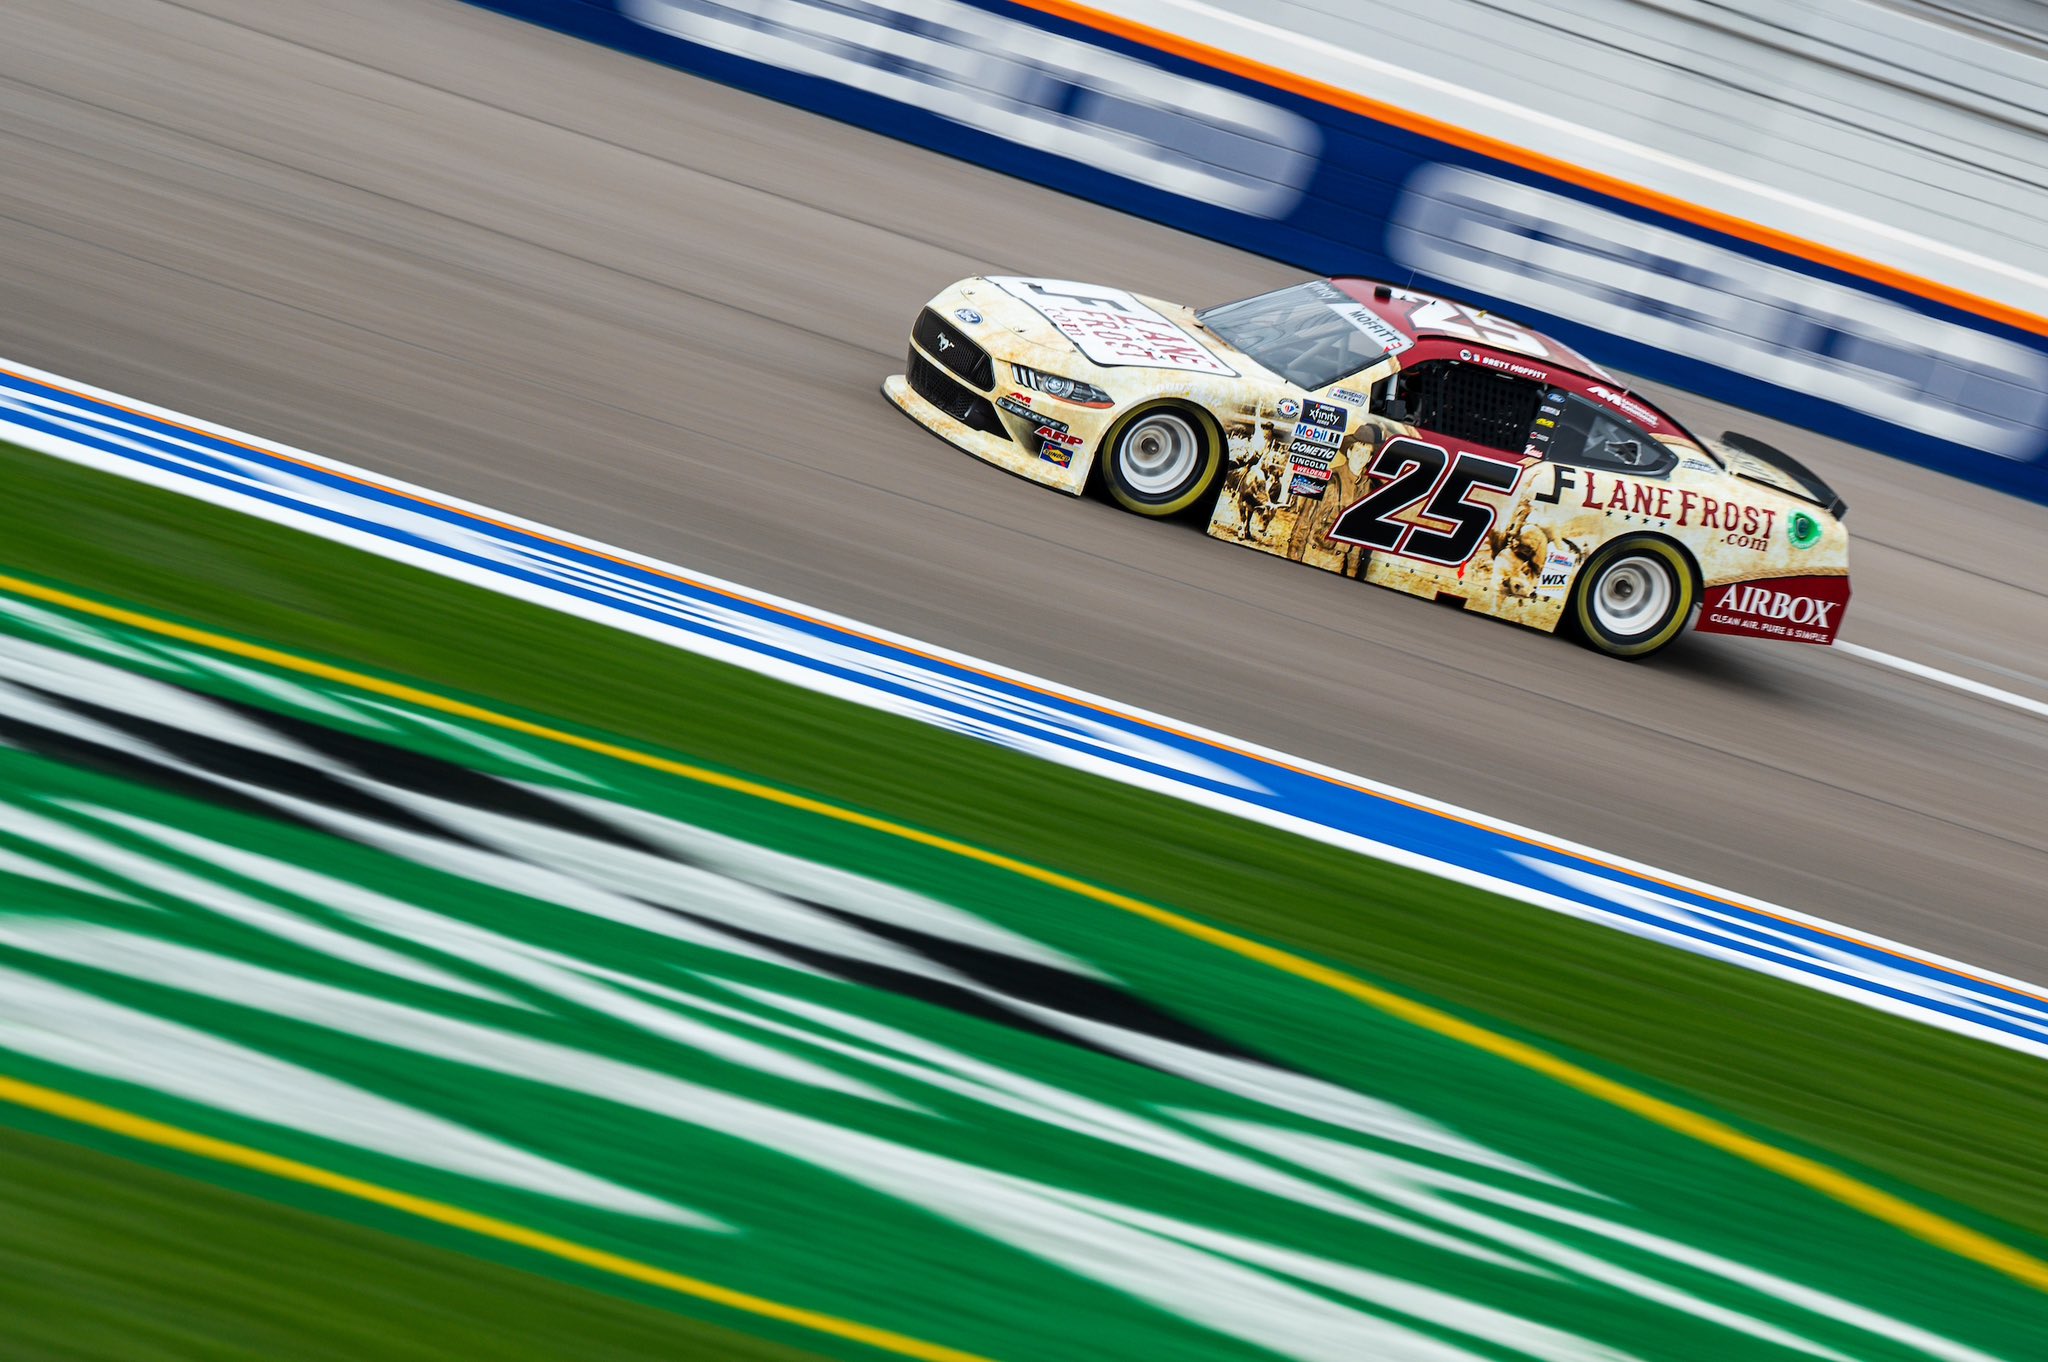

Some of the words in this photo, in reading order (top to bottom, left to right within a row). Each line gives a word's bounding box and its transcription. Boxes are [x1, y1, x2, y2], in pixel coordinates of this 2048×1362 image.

[1348, 310, 1401, 342] MOFFITT
[1482, 357, 1511, 370] BRETT
[1510, 364, 1547, 380] MOFFITT
[1309, 408, 1340, 425] xfinity
[1035, 426, 1084, 445] ARP
[1295, 424, 1328, 441] Mobil
[1044, 449, 1070, 462] SUNOCO
[1290, 441, 1336, 459] COMETIC
[1291, 456, 1326, 470] LINCOLN
[1296, 465, 1327, 478] WELDERS
[1328, 435, 1524, 568] 25
[1719, 532, 1769, 552] .com
[1541, 574, 1567, 585] WIX
[1714, 583, 1835, 629] AIRBOX
[1709, 613, 1742, 626] CLEAN
[1760, 623, 1787, 635] PURE
